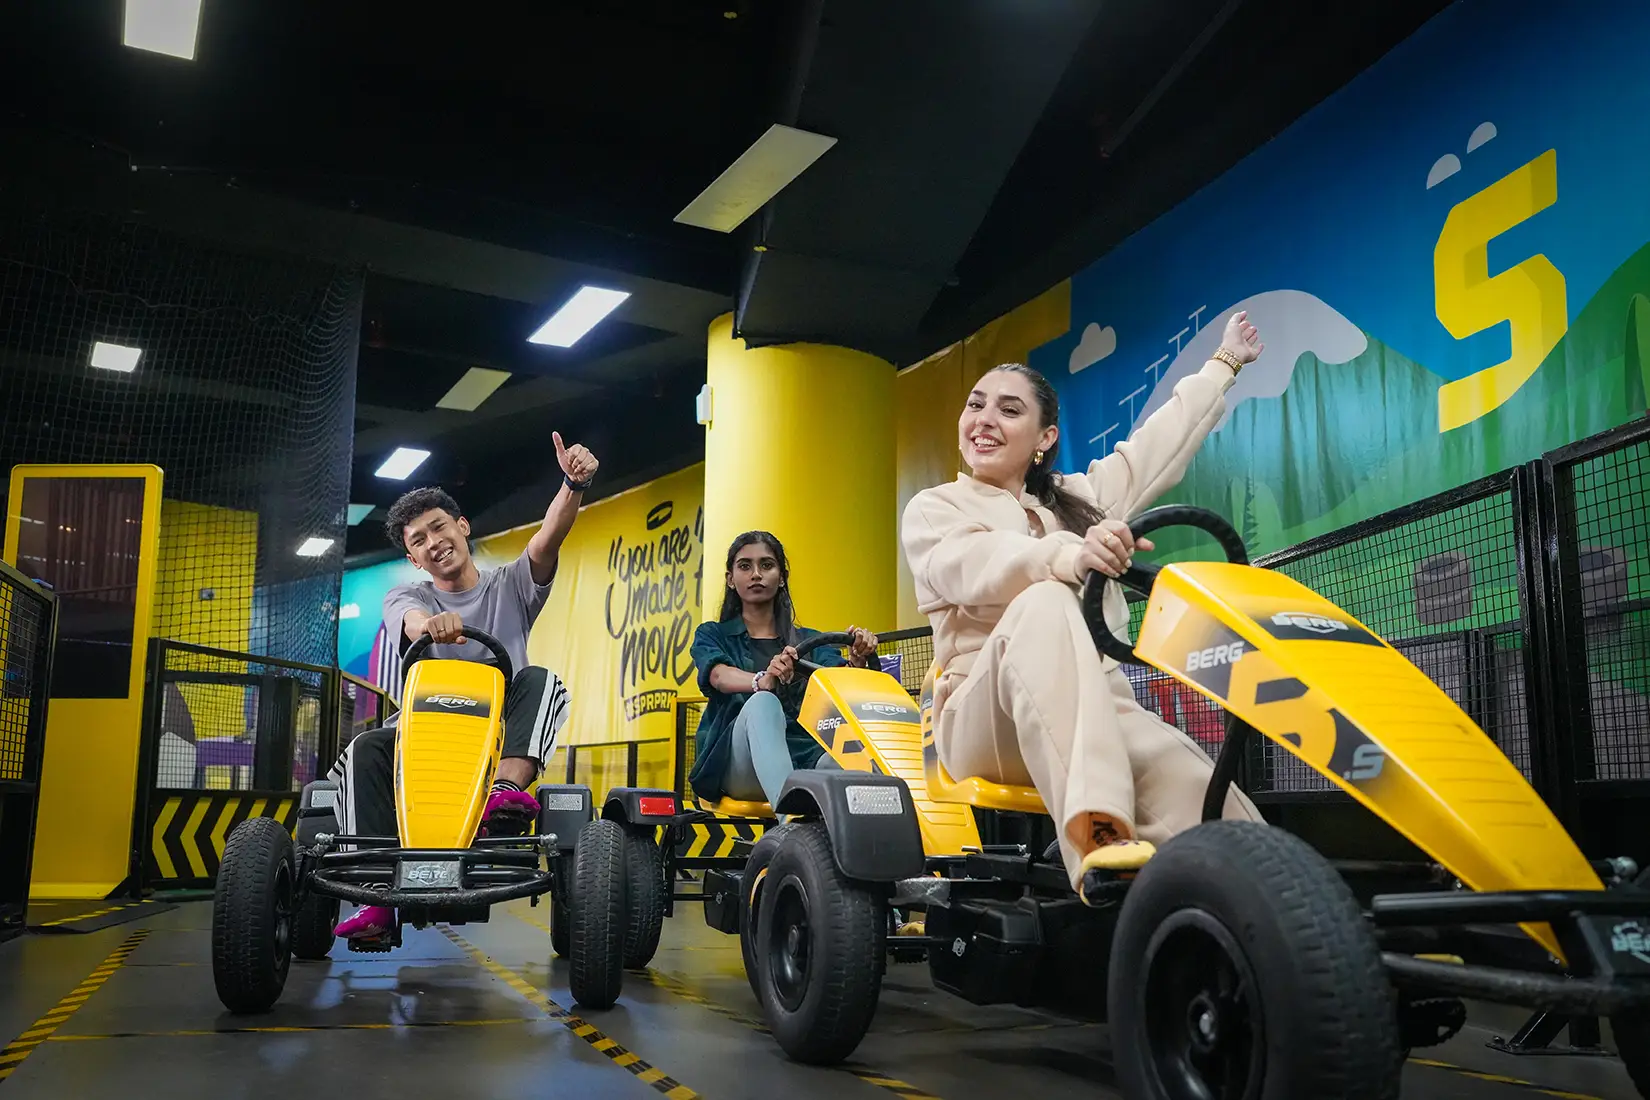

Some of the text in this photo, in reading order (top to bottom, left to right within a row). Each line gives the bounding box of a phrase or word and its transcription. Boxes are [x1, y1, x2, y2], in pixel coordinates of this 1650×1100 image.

[630, 561, 687, 625] made
[620, 610, 695, 698] move
[1186, 641, 1245, 672] BERG
[425, 695, 478, 708] BERG
[861, 702, 907, 715] BERG
[816, 717, 842, 731] BERG
